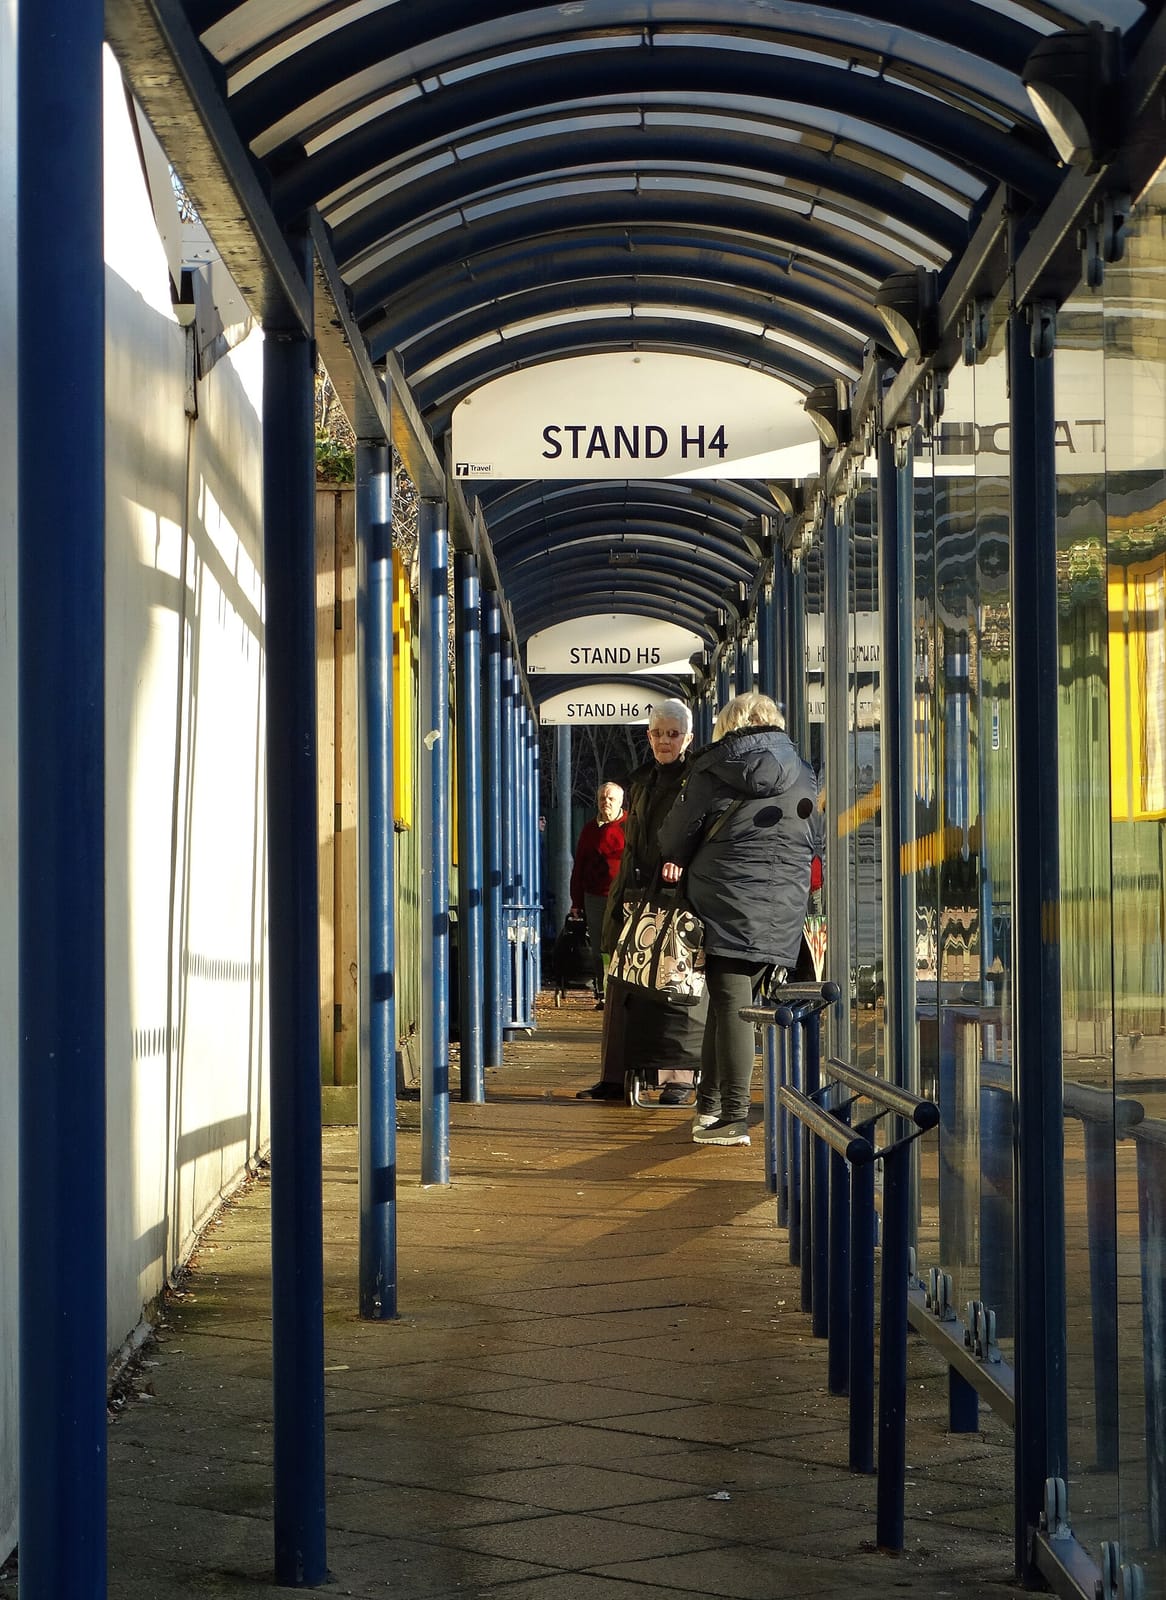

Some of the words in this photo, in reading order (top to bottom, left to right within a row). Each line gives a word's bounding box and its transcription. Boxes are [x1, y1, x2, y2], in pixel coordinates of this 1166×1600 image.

[541, 425, 668, 459] STAND
[681, 425, 729, 459] H4
[470, 464, 491, 472] Travel
[570, 647, 631, 664] STAND
[637, 647, 661, 664] H5
[567, 703, 616, 717] STAND
[620, 703, 640, 717] H6
